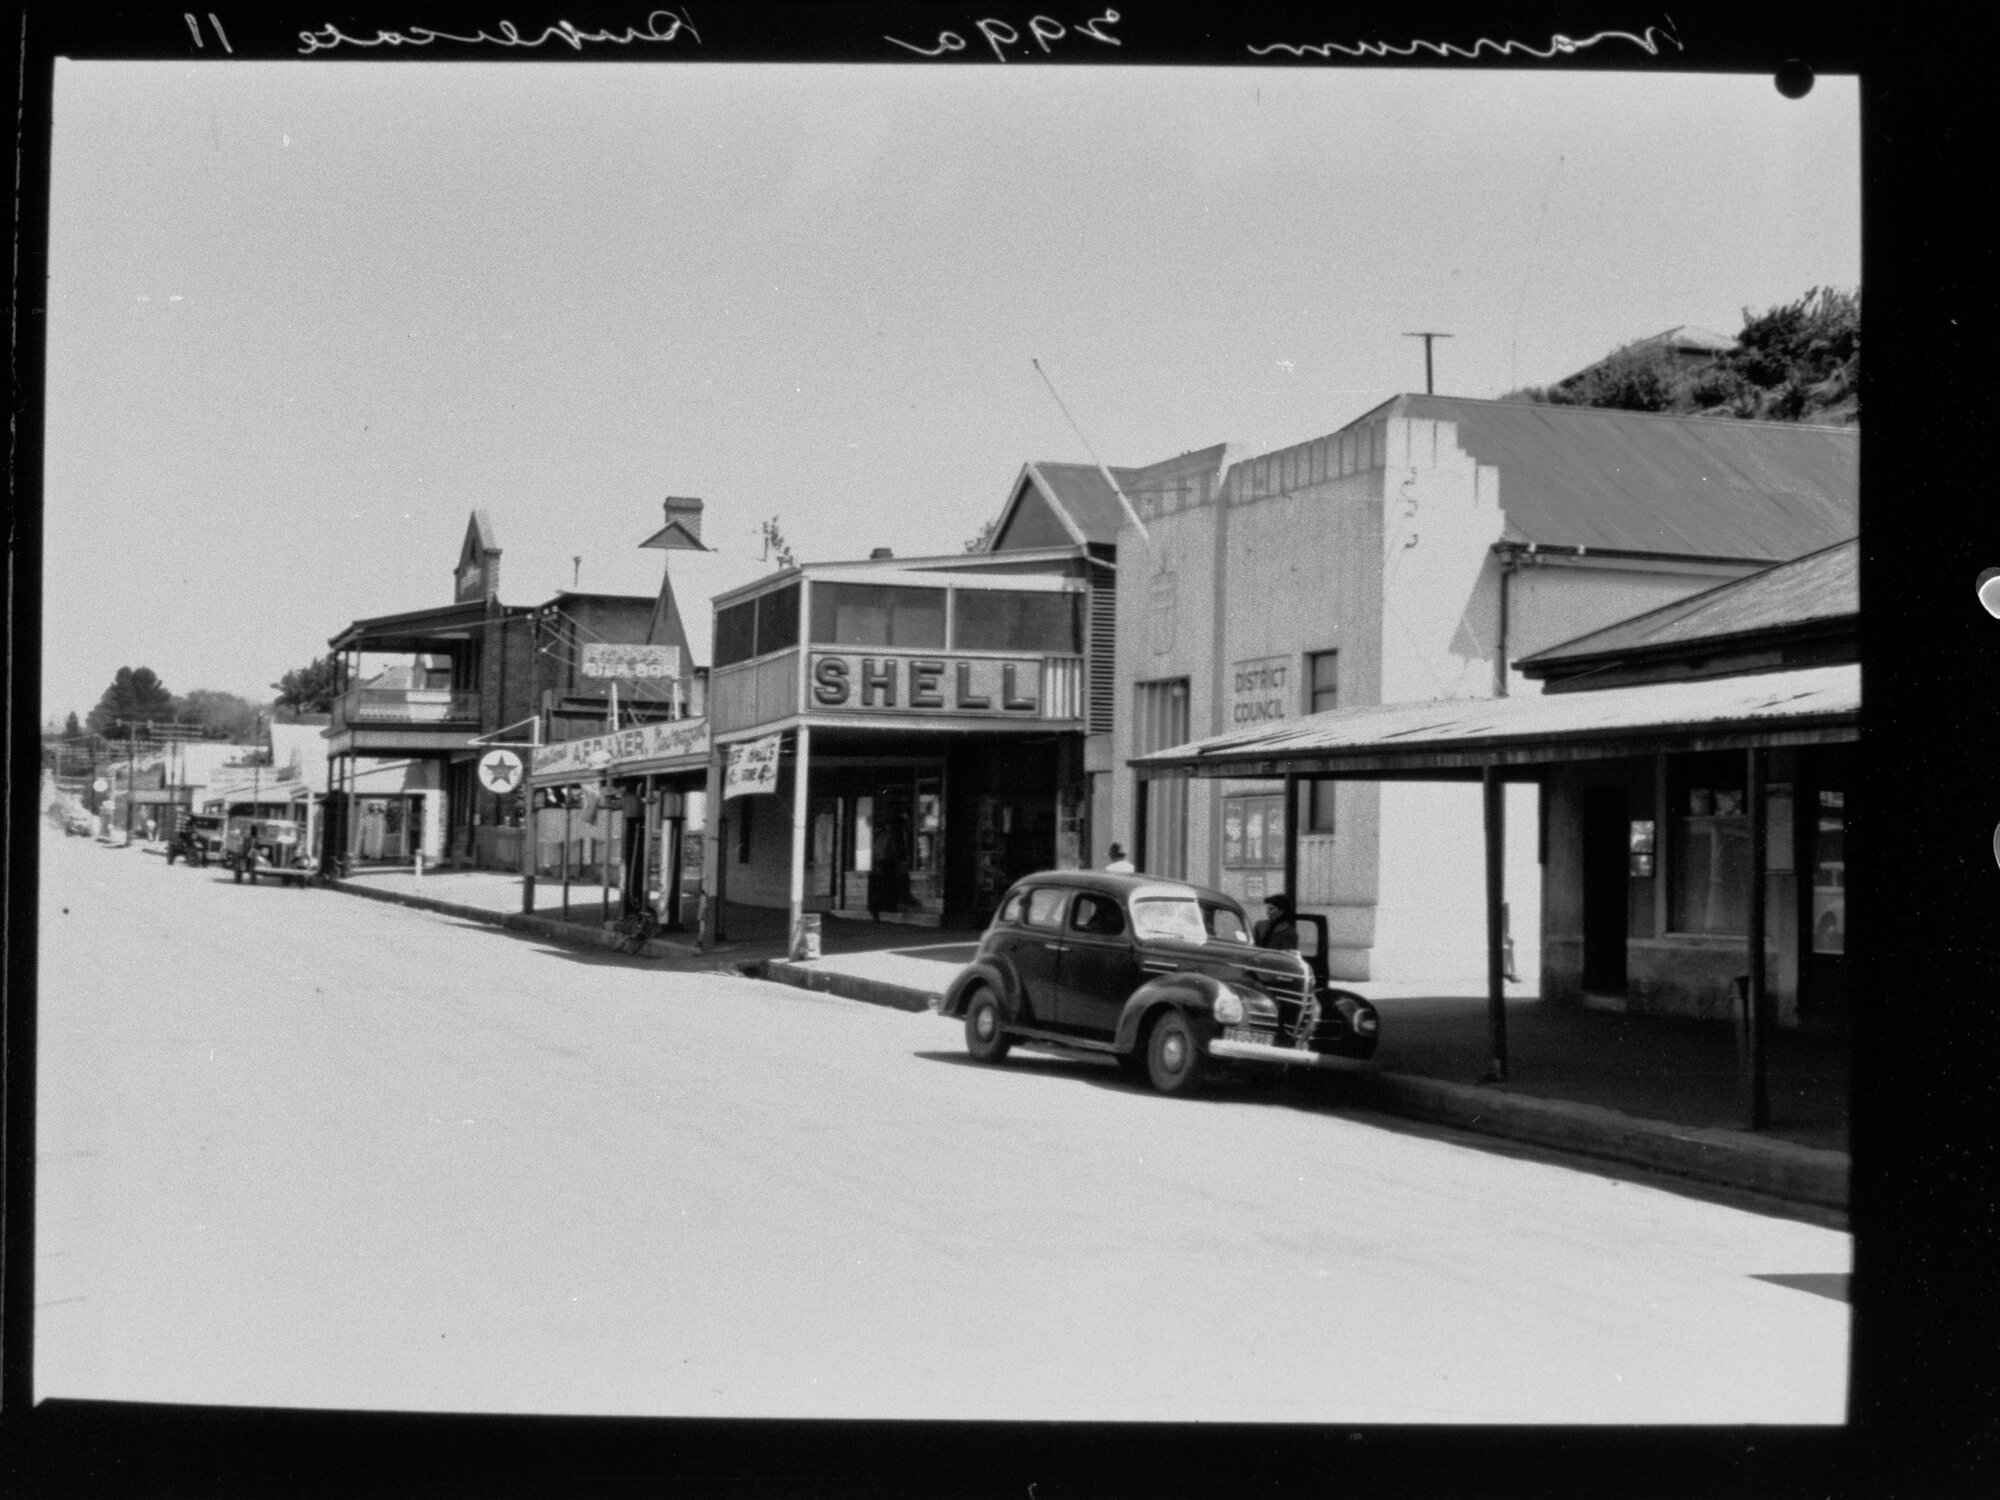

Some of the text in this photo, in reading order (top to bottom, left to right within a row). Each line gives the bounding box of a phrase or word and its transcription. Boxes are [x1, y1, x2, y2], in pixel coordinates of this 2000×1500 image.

[814, 657, 1036, 710] SHELL
[1234, 667, 1287, 693] DISTRICT
[1233, 699, 1286, 723] COUNCIL
